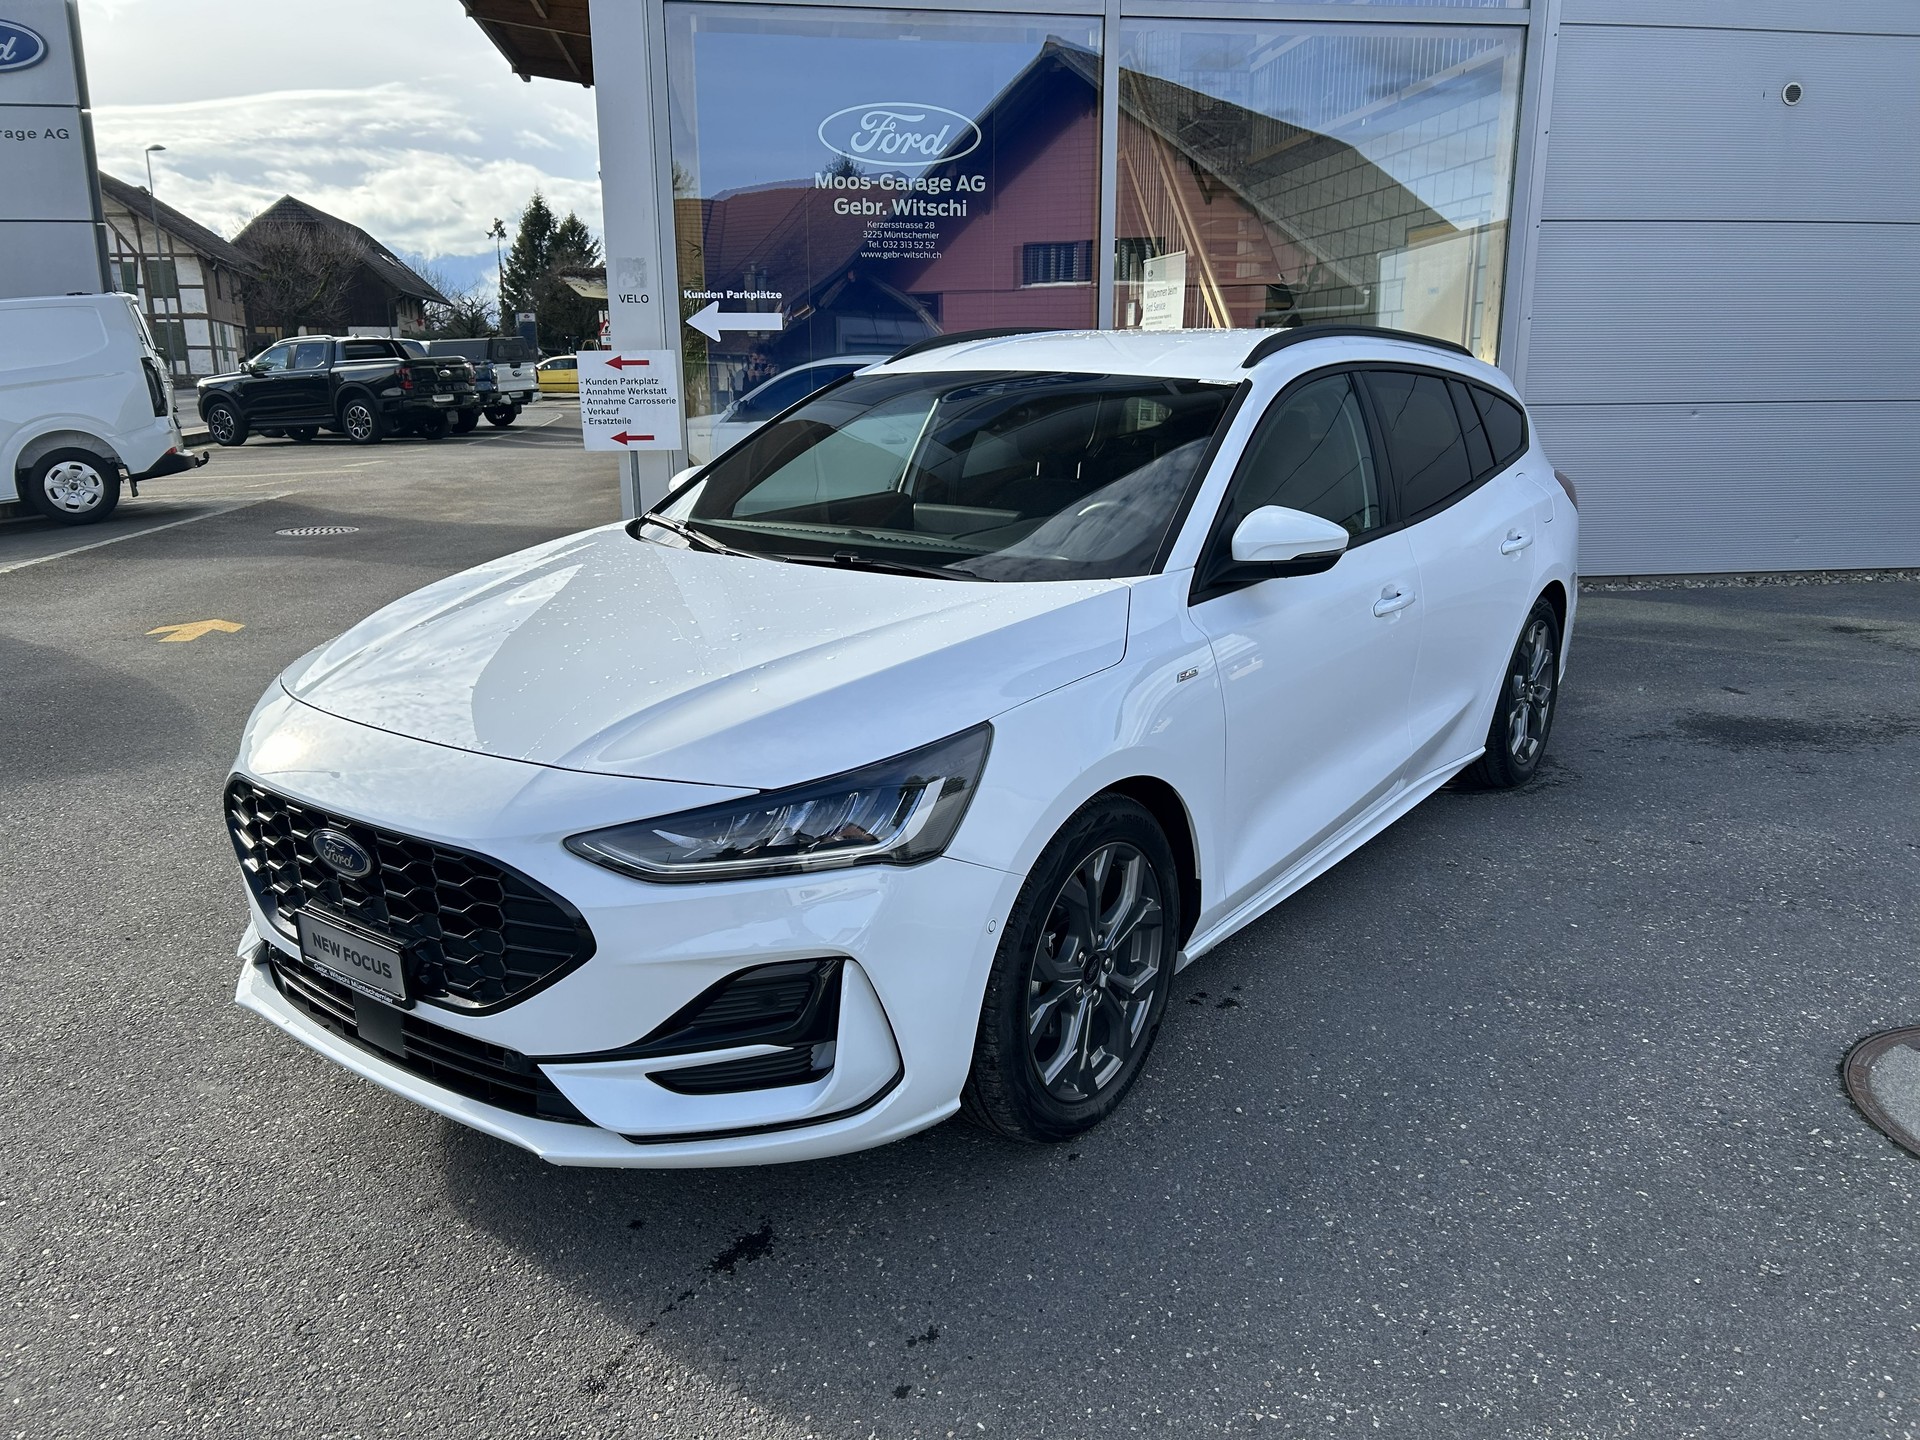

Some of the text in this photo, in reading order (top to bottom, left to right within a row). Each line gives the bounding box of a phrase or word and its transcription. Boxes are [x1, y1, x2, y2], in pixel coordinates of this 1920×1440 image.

[44, 128, 70, 140] AG
[851, 110, 950, 155] Ford
[814, 171, 986, 195] Moos-Garage AG
[833, 197, 967, 217] Gebr. Witschi
[866, 221, 935, 230] Kerzersstrasse 28
[863, 230, 940, 240] 3225 Müntschemier
[868, 240, 936, 249] Tel. 032 313 52 52
[860, 250, 942, 260] www.gebr-witschi.ch
[618, 294, 650, 304] VELO
[683, 289, 783, 301] Kunden Parkplätze
[585, 378, 659, 387] Kunden Parkplatz
[585, 387, 668, 396] Annahme Werkstatt
[586, 397, 677, 405] Annahme Carrosserie
[587, 407, 620, 416] Verkauf
[588, 417, 632, 425] Ersatzteile
[323, 840, 354, 869] Ford
[312, 931, 393, 980] NEW FOCUS
